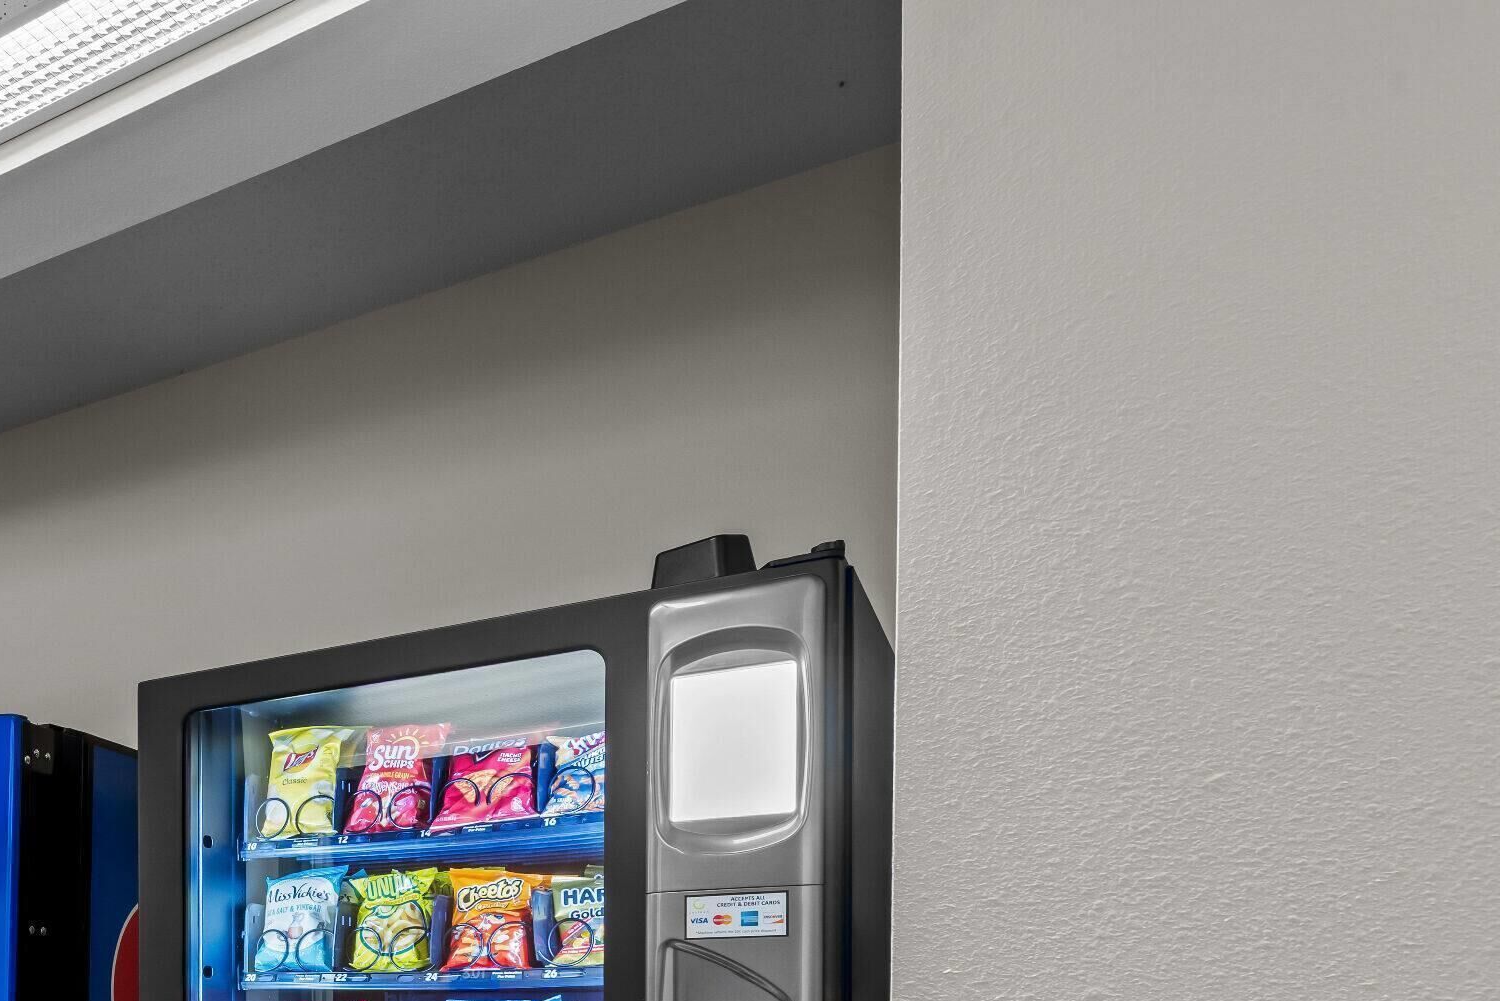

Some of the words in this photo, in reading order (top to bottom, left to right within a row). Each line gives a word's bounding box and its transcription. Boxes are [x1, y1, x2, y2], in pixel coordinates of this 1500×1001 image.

[453, 738, 527, 754] Doritos
[383, 759, 414, 769] CHIPS
[281, 777, 308, 786] Classic
[543, 818, 557, 826] 16
[420, 830, 432, 838] 14
[338, 836, 349, 844] 12
[292, 882, 331, 901] Vickie's
[457, 878, 524, 911] Cheetos
[244, 974, 257, 982] 20
[335, 974, 348, 982] 22
[425, 973, 438, 982] 24
[544, 970, 558, 978] 26
